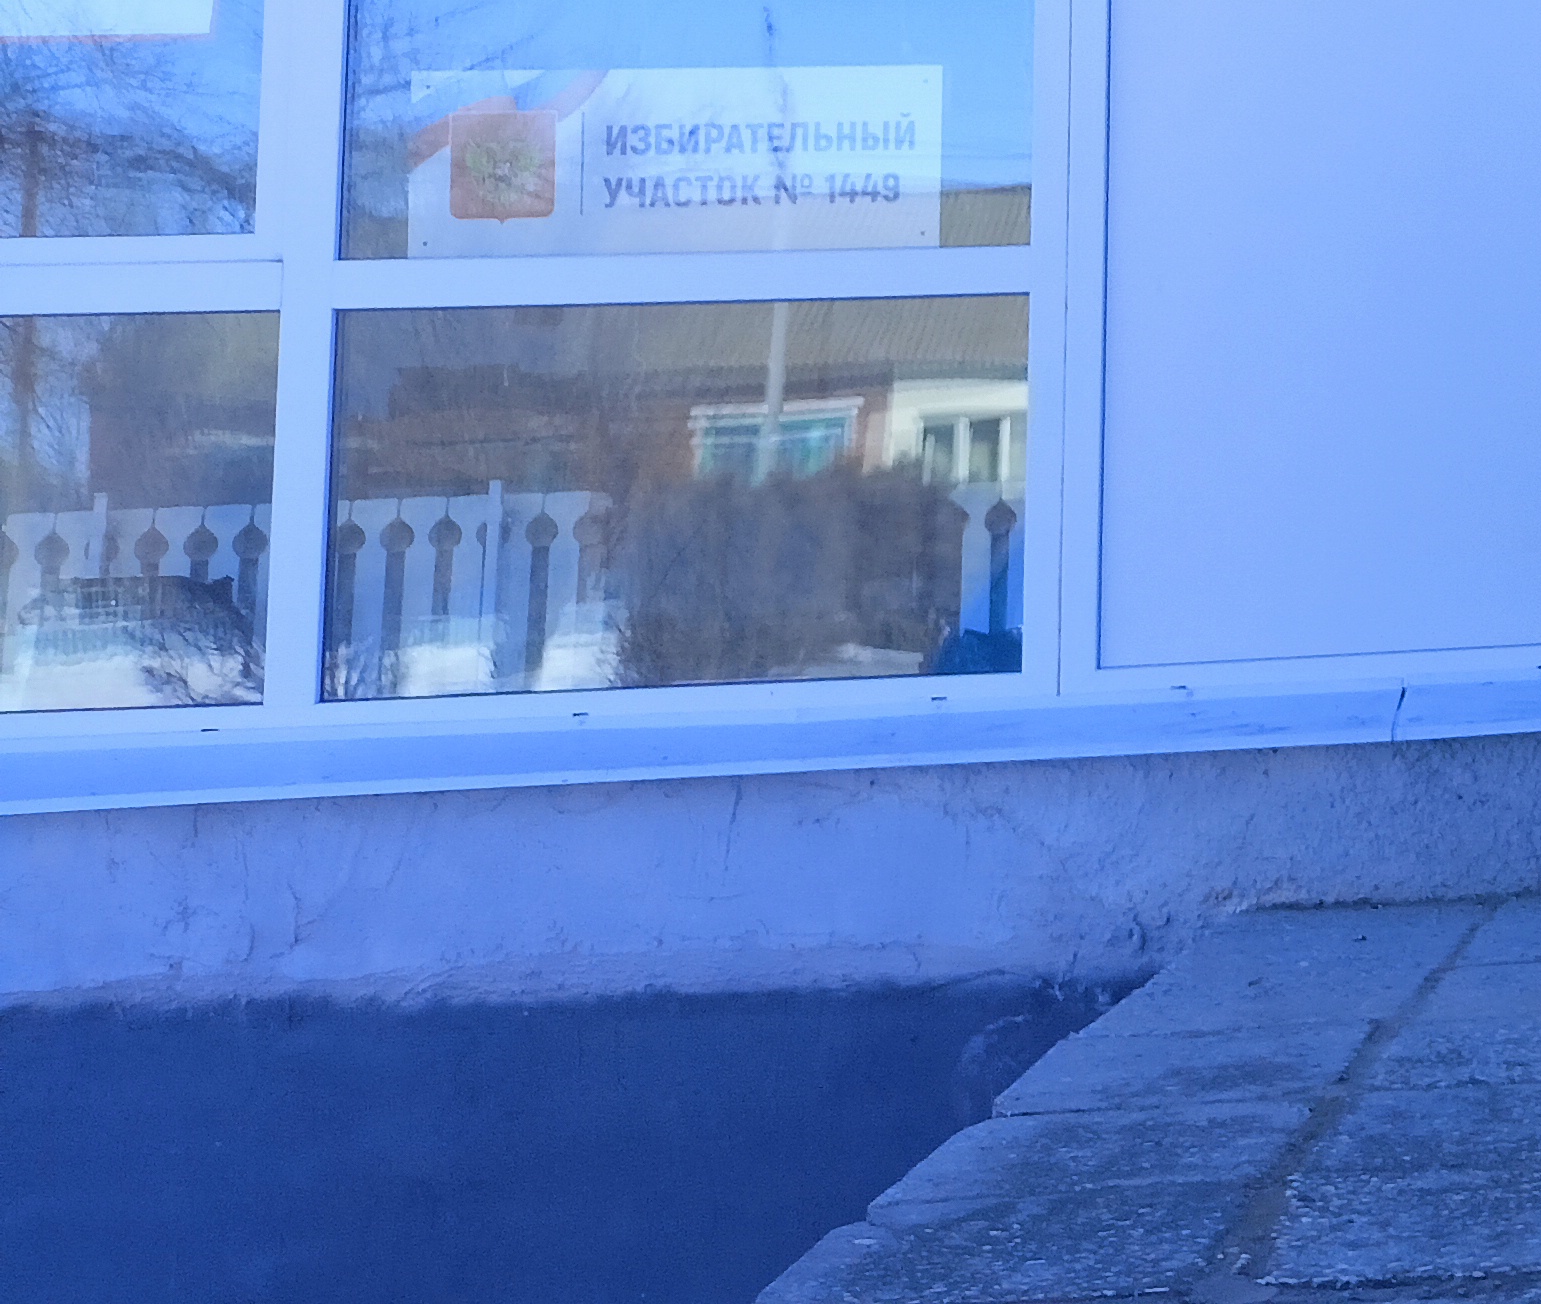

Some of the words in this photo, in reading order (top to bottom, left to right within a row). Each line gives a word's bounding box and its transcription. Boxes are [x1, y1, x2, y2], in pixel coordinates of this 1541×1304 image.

[604, 112, 917, 157] ИЗБИРАТЕЛЬНЫЙ
[603, 175, 762, 209] УЧАСТОК
[774, 175, 813, 206] №
[824, 172, 901, 204] 1449
